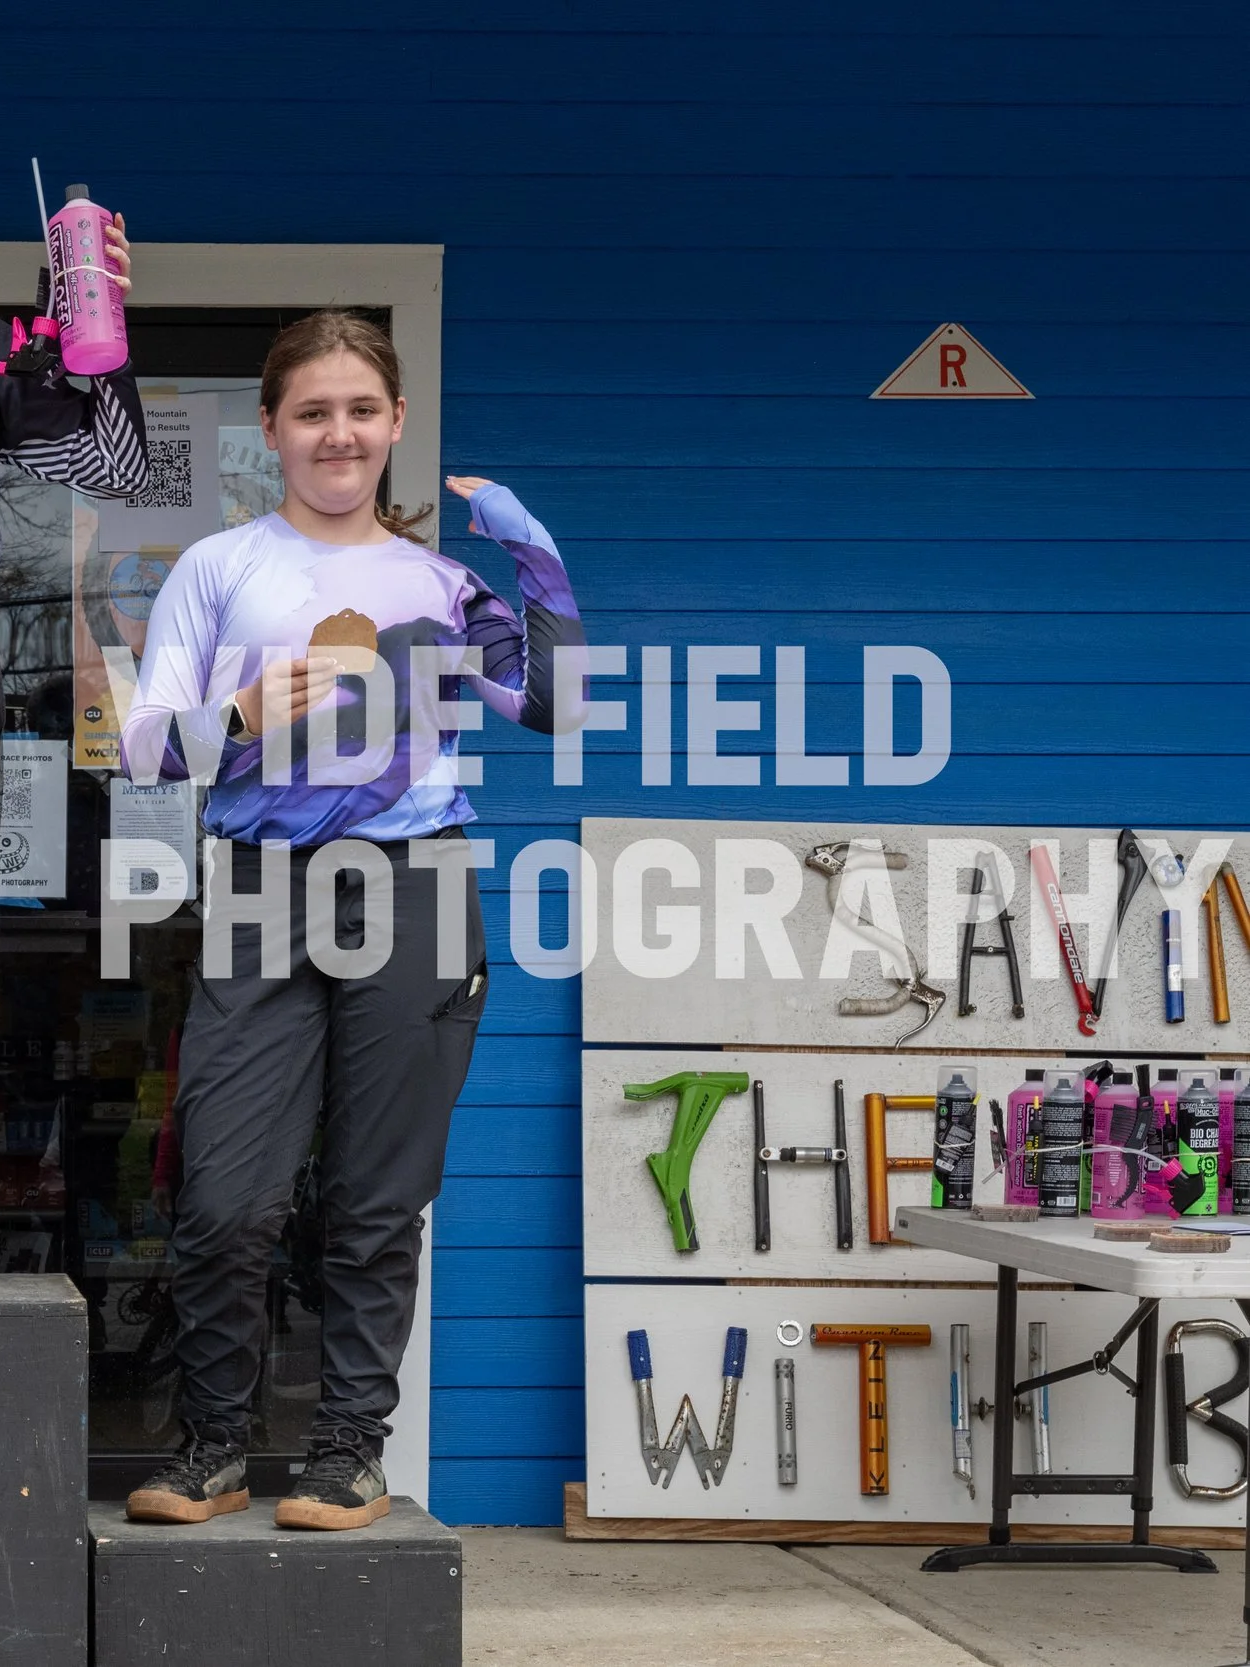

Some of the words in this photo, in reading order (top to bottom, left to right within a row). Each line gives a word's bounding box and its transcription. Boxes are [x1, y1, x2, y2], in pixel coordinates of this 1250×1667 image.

[940, 344, 967, 388] R
[146, 409, 188, 419] Mountain
[157, 423, 191, 432] Results
[86, 711, 101, 719] GU
[1, 879, 49, 887] PHOTOGRAPHY
[1046, 883, 1084, 984] cannondale
[1190, 1128, 1204, 1139] BIO
[822, 1326, 886, 1337] Quantum
[784, 1402, 793, 1431] FURIO
[868, 1341, 885, 1491] KLEIN
